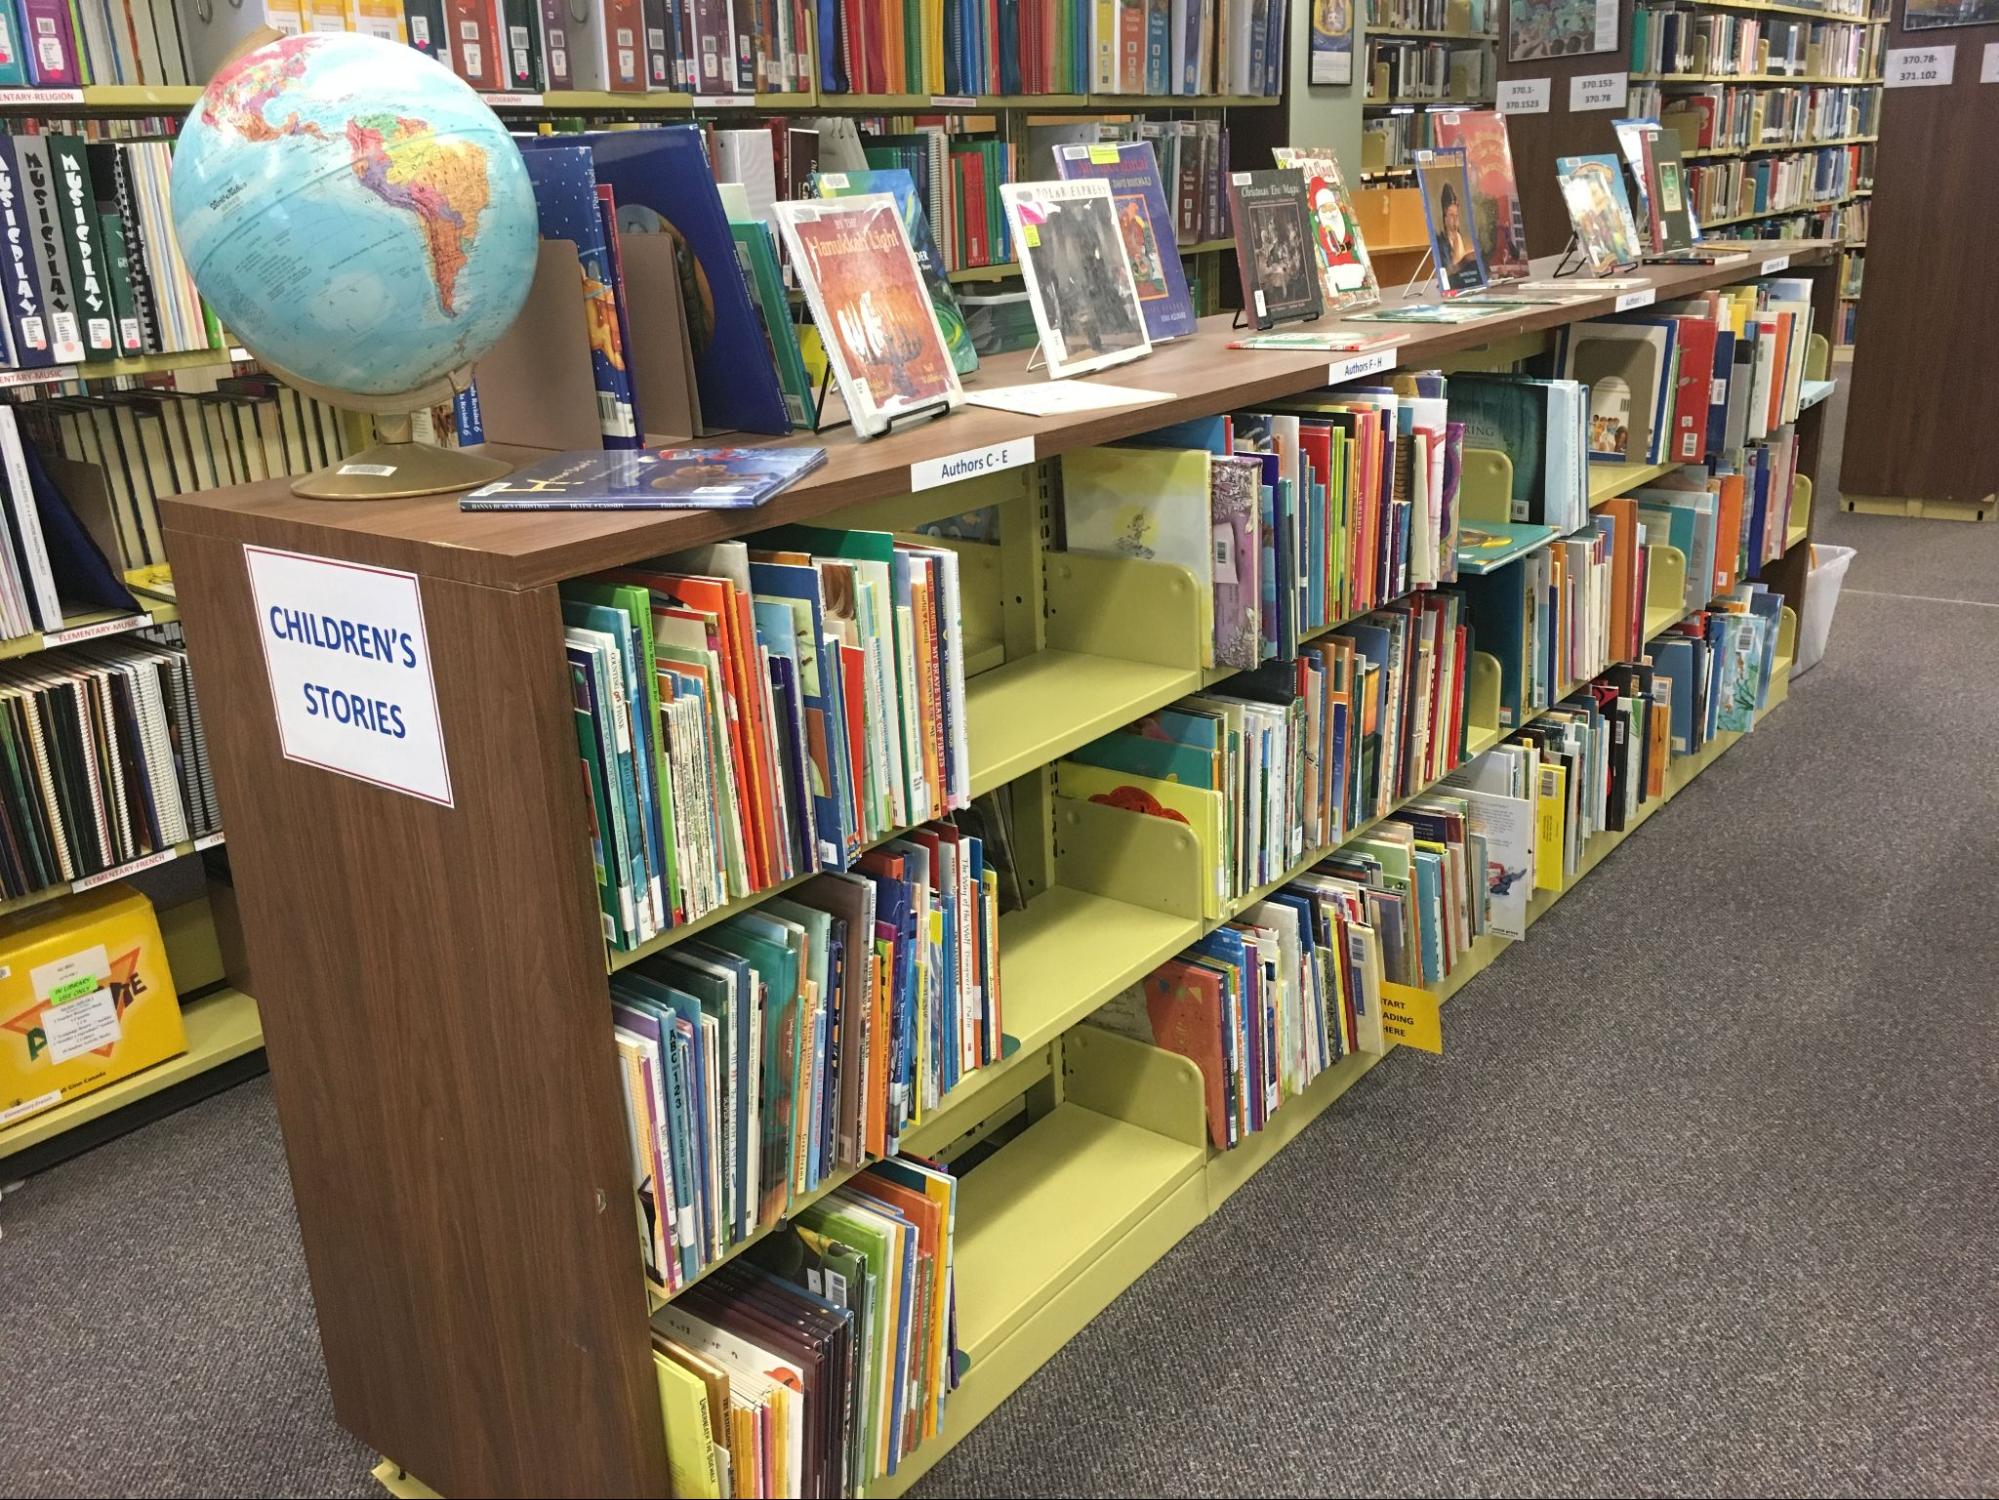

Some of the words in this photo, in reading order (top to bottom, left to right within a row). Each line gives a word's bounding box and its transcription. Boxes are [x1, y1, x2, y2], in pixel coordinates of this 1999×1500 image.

[1900, 70, 1937, 80] 371.102
[1036, 186, 1067, 199] POLAR
[1241, 185, 1269, 198] Christmas
[25, 152, 69, 313] MUSICPLAY
[61, 153, 103, 312] MUSICPLAY
[804, 232, 868, 257] Hanukkah
[868, 228, 900, 252] Light
[1344, 360, 1368, 376] Authors
[1369, 359, 1373, 370] F
[1378, 357, 1382, 368] H
[942, 458, 984, 478] Authors
[986, 454, 993, 468] C
[1002, 450, 1008, 464] E
[58, 620, 139, 642] ELEMENTARY-MUSIC
[270, 606, 416, 668] CHILDREN'S
[610, 652, 620, 690] COUNTING
[613, 691, 622, 703] on
[932, 646, 938, 662] MY
[937, 722, 943, 735] OF
[304, 682, 406, 738] STORIES
[615, 704, 625, 730] FRANK
[84, 854, 165, 887] ELEMENTARY-FRENCH
[960, 858, 968, 875] The
[961, 876, 970, 896] Way
[962, 900, 970, 908] of
[1382, 998, 1406, 1010] TART
[700, 1398, 710, 1440] UNDERNEATH
[707, 1453, 716, 1484] SIDEWALK
